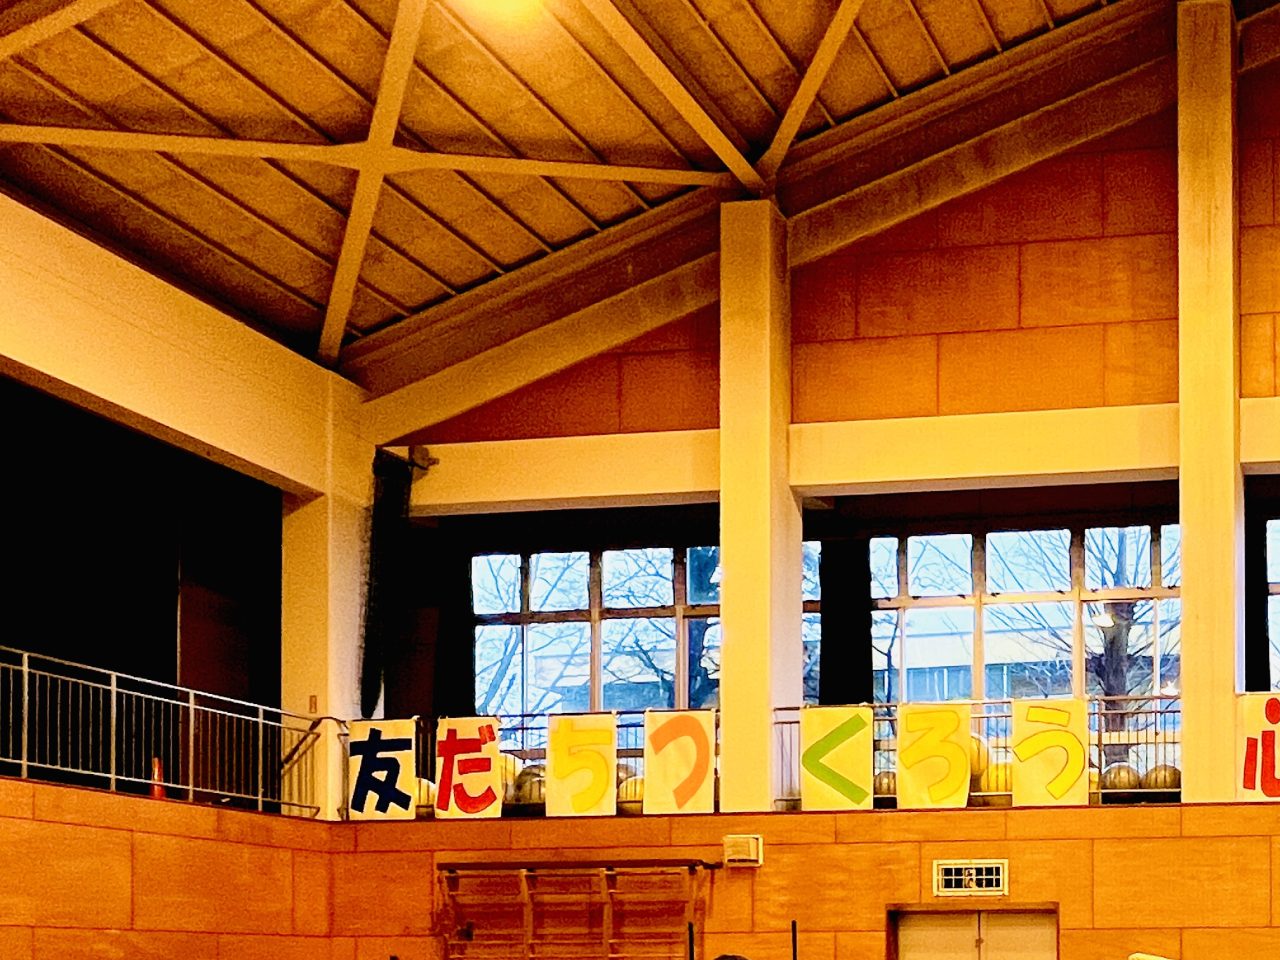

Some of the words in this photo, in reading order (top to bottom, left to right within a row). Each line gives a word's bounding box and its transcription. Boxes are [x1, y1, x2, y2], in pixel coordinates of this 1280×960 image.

[349, 705, 1087, 814] 友だちつくろう
